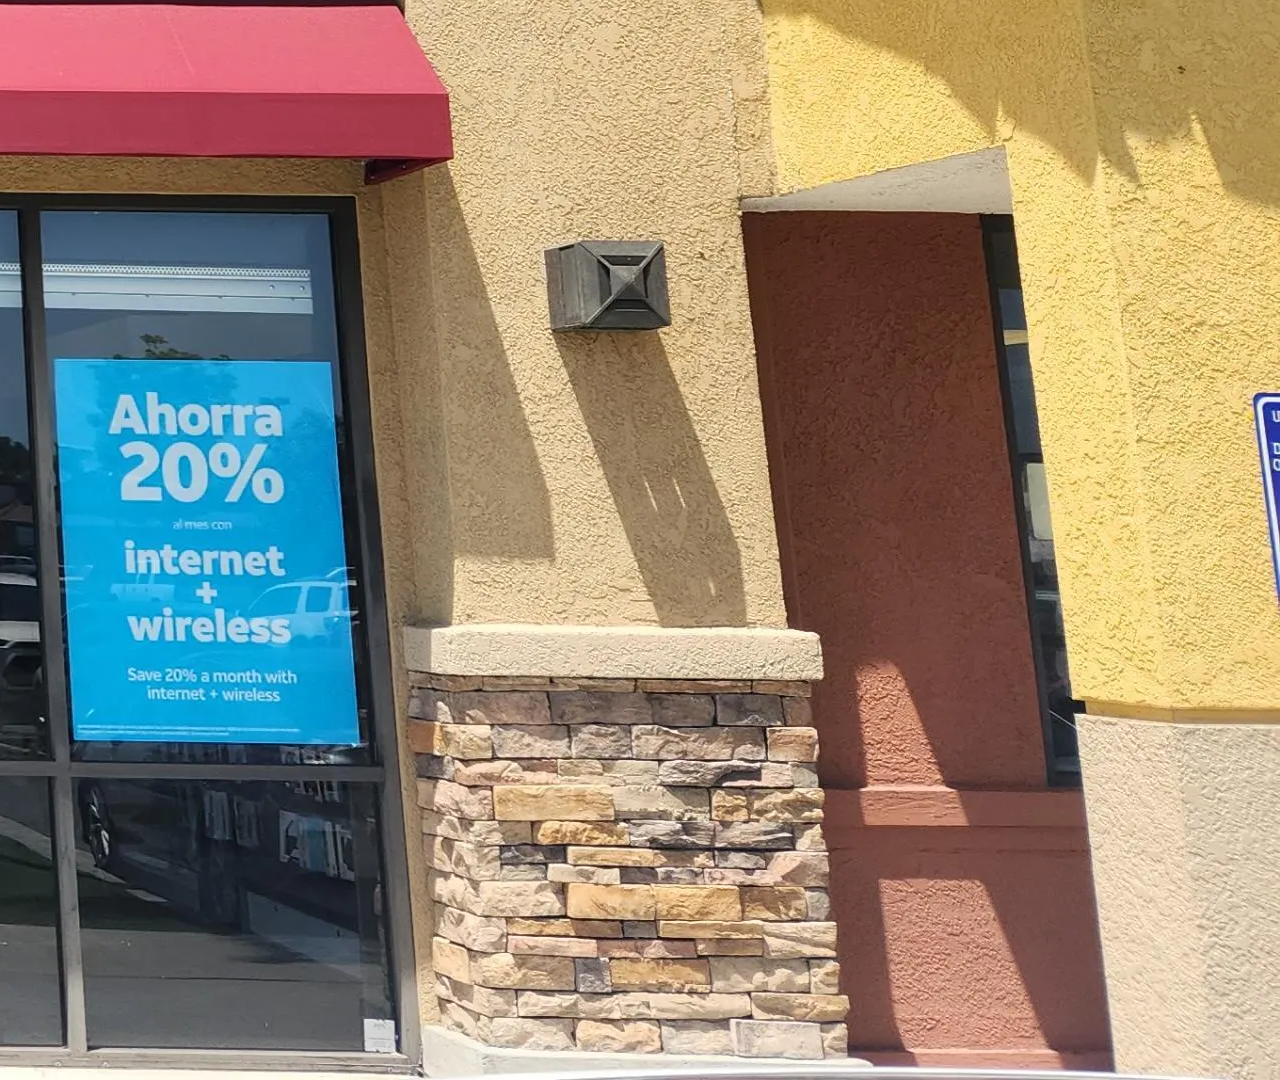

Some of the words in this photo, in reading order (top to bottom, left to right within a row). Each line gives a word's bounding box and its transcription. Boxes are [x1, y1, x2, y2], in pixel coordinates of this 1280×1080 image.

[109, 391, 283, 437] Ahorra
[120, 441, 285, 504] 20%
[184, 521, 209, 530] mes
[211, 521, 233, 530] con
[124, 540, 286, 577] internet
[196, 582, 218, 604] +
[127, 608, 291, 644] wireless
[127, 667, 162, 682] Save
[165, 668, 197, 682] 20%
[201, 672, 210, 683] a
[213, 670, 262, 683] month
[265, 670, 298, 684] with
[147, 685, 206, 701] internet
[210, 690, 218, 698] +
[222, 688, 281, 702] wireless
